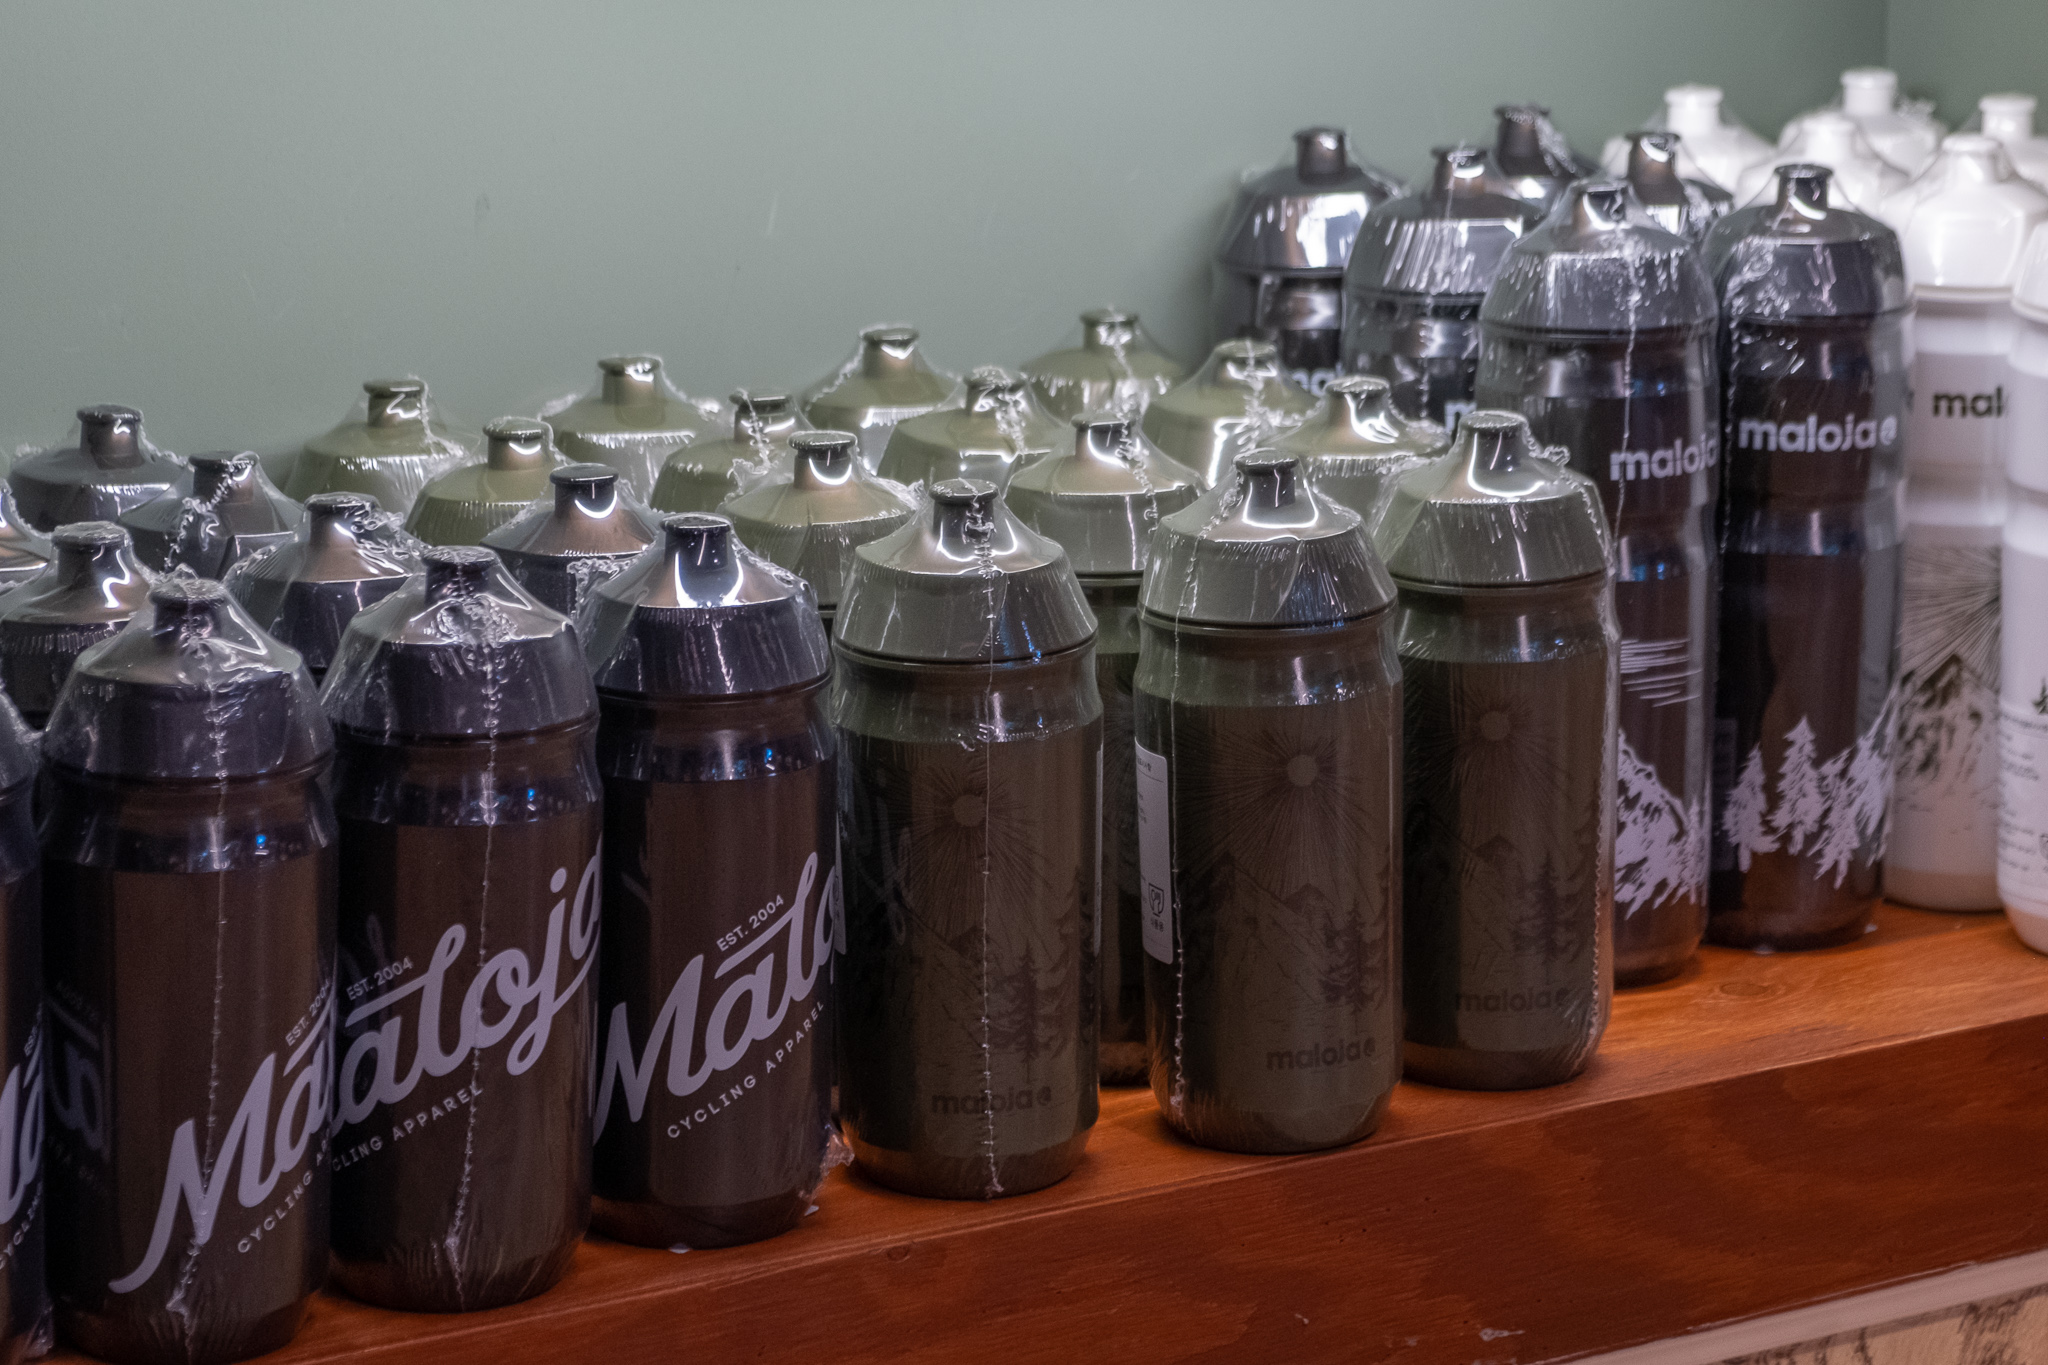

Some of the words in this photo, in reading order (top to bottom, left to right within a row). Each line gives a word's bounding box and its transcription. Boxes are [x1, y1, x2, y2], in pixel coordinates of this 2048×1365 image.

[1933, 385, 2004, 418] mal
[1738, 412, 1877, 453] maloja
[1610, 433, 1718, 480] maloja
[716, 926, 749, 952] EST.
[748, 894, 785, 930] 2004
[330, 833, 600, 1138] aloja
[346, 979, 374, 1001] EST.
[373, 956, 414, 986] 2004
[592, 851, 835, 1147] Malo
[1455, 986, 1551, 1012] maloja
[285, 1015, 309, 1047] EST.
[1266, 1039, 1361, 1070] maloja
[667, 1075, 757, 1138] CYCLING
[765, 1001, 825, 1074] APPAREL
[332, 1135, 383, 1172] CLING
[392, 1082, 484, 1141] APPAREL
[238, 1171, 313, 1253] CYCLING
